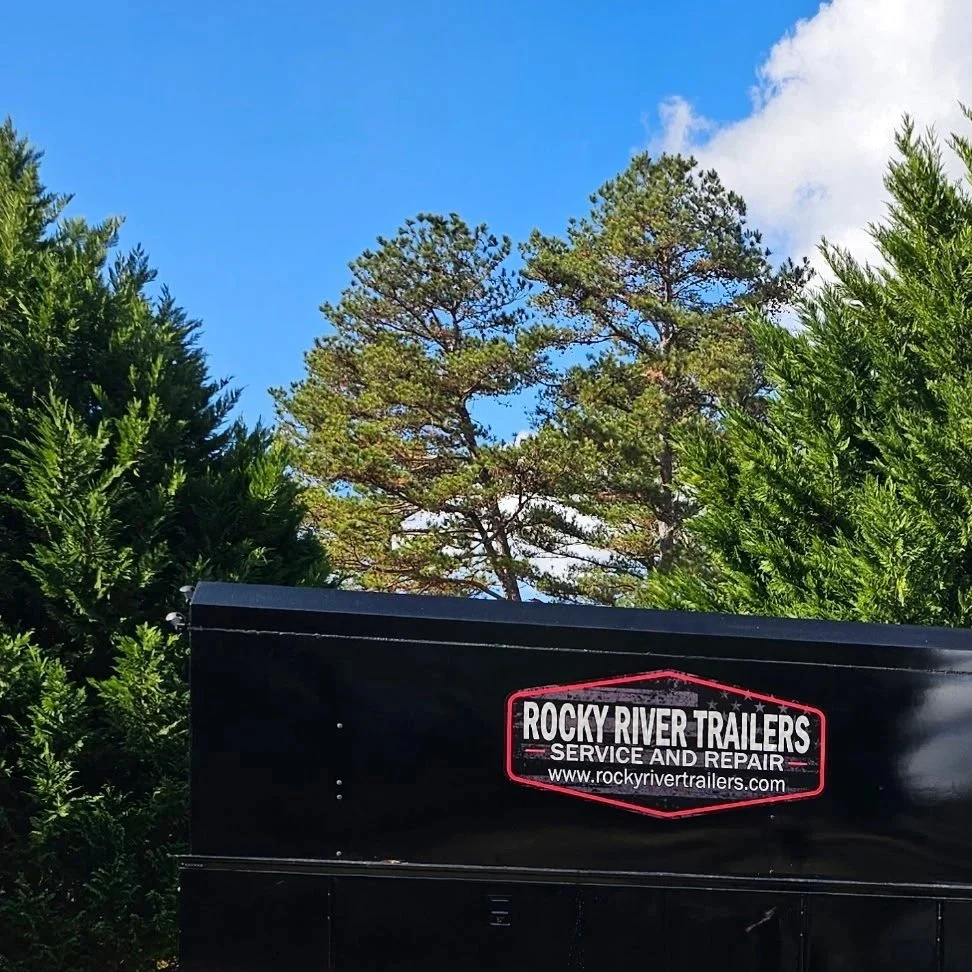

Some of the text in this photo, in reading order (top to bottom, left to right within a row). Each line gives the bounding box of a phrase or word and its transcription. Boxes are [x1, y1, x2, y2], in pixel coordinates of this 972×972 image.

[523, 701, 811, 754] ROCKY RIVER TRAILERS
[550, 743, 785, 771] SERVICE AND REPAIR
[547, 767, 786, 793] www.rockyrivertrailers.com
